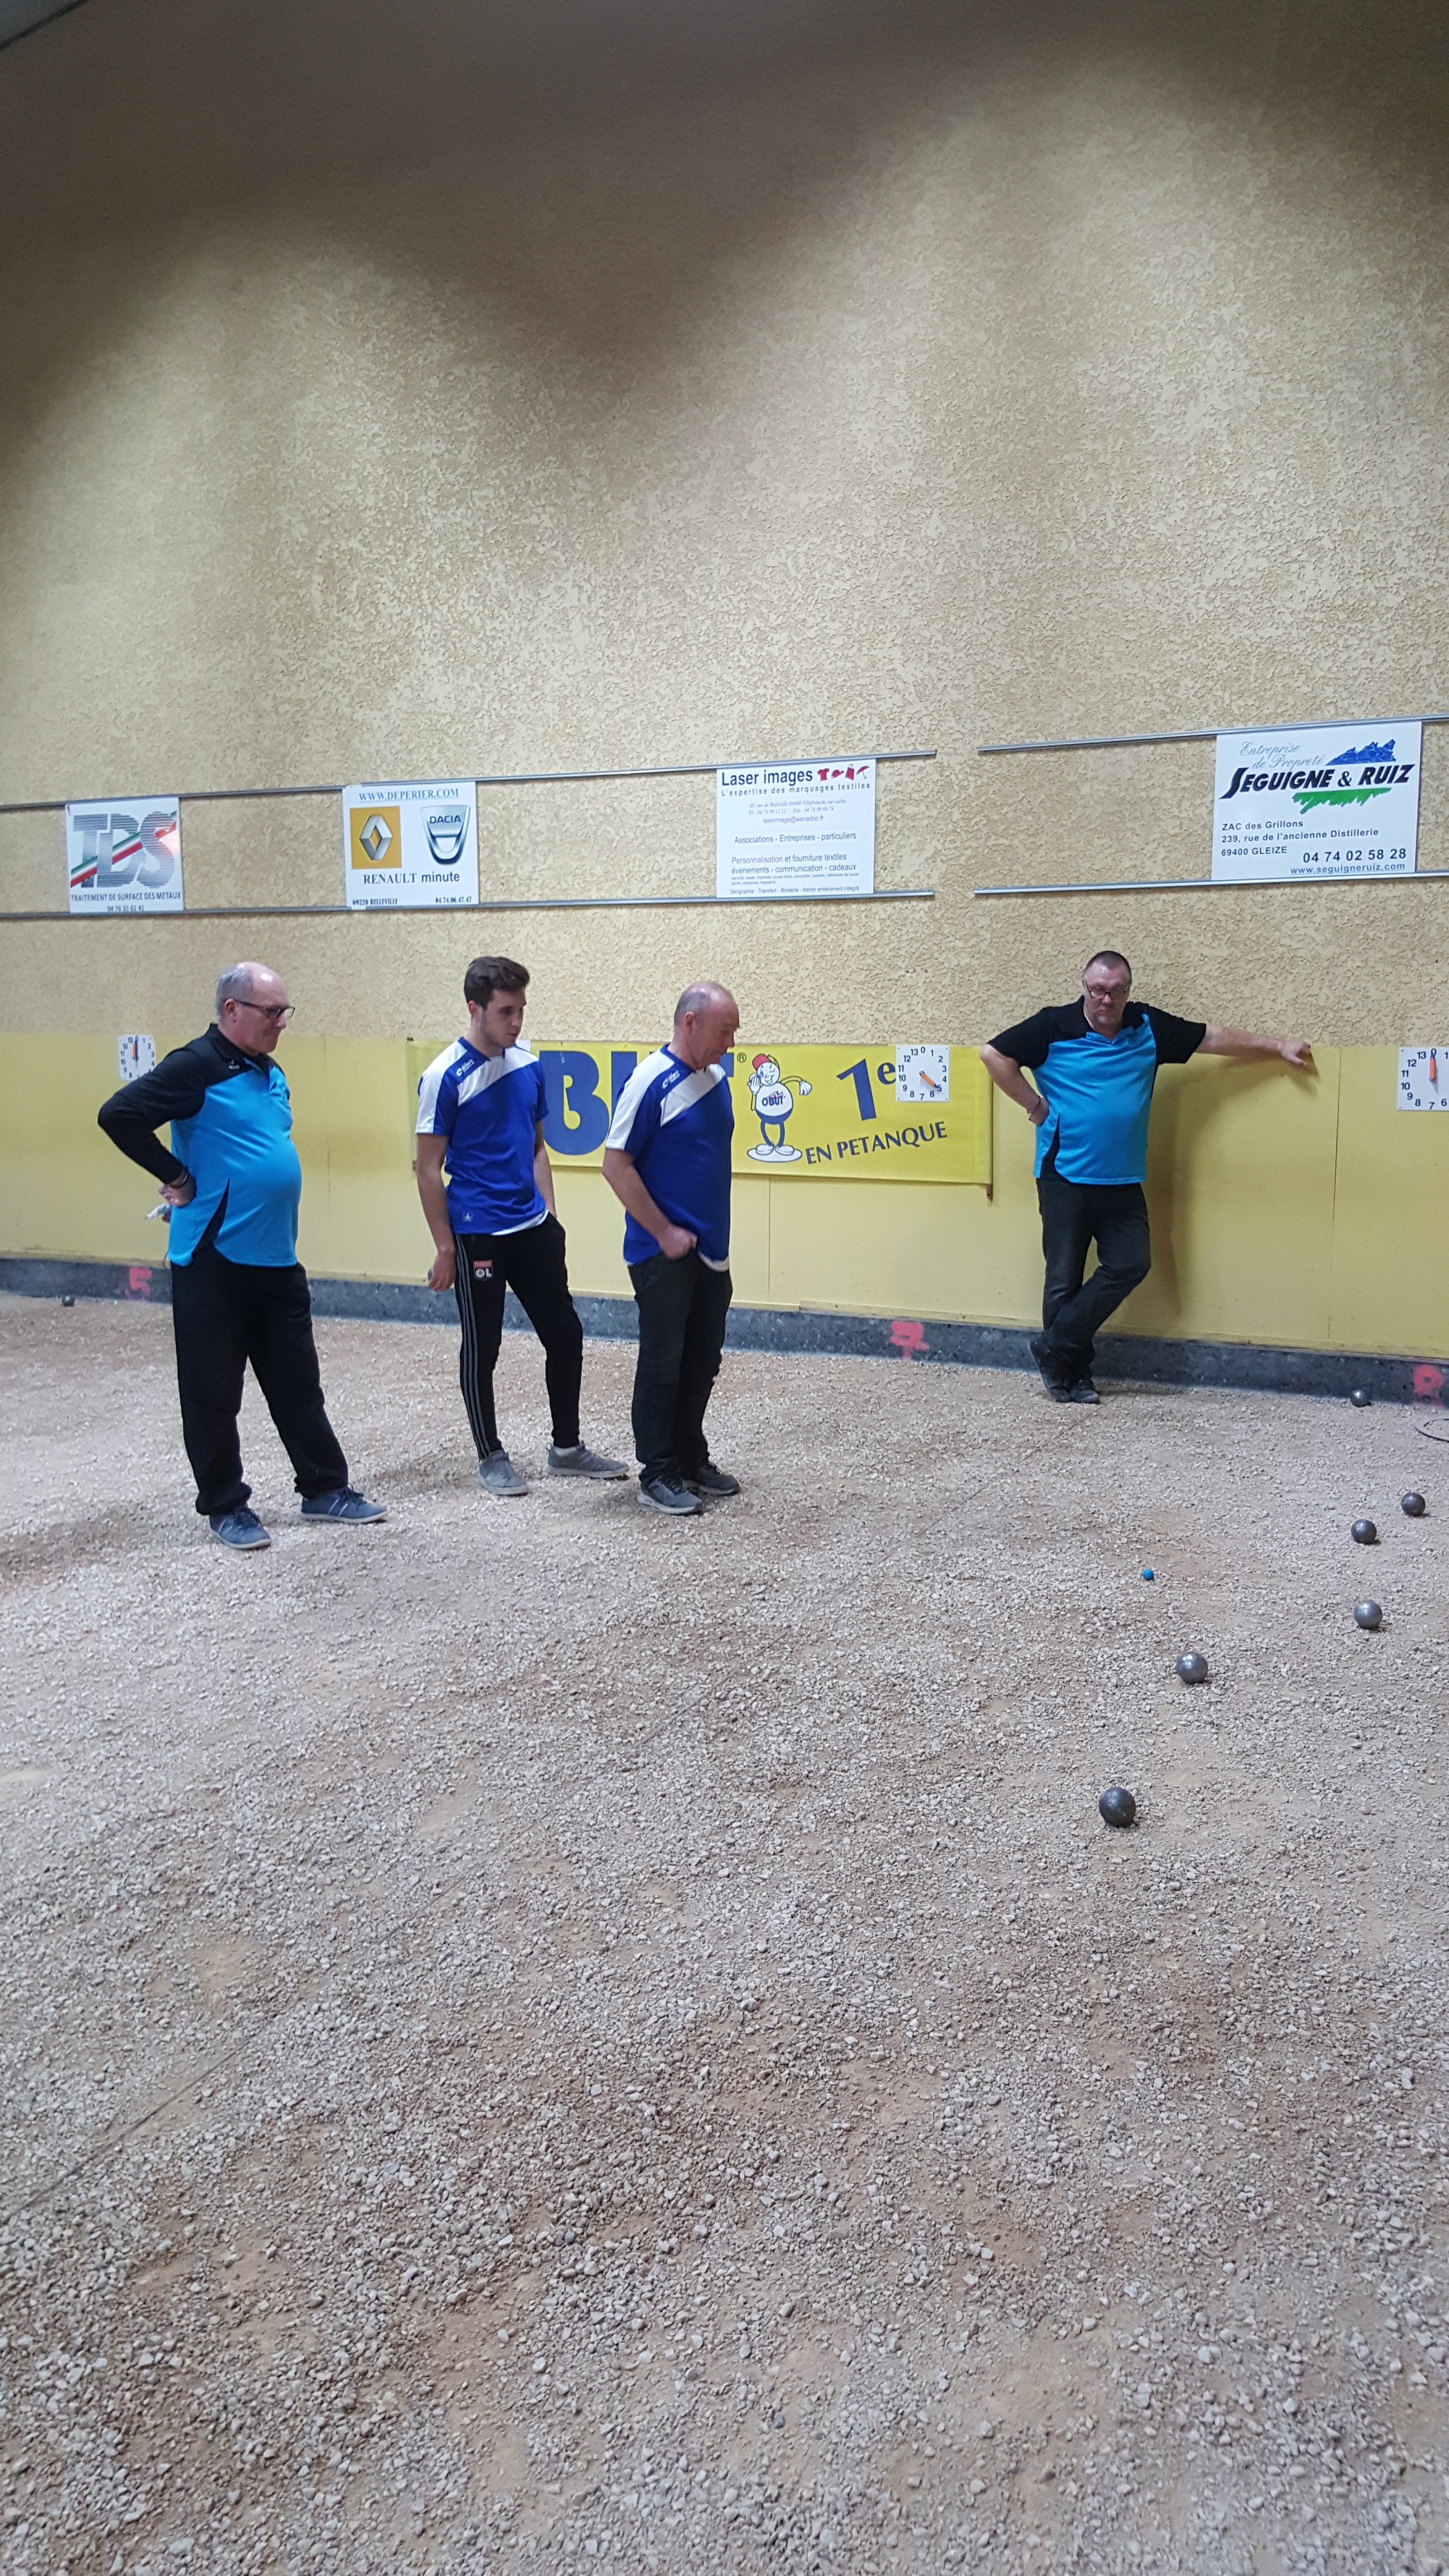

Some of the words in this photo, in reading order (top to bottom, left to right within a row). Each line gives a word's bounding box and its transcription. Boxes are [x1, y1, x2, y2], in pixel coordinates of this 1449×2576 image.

[1240, 741, 1300, 758] Entreprise
[1252, 757, 1266, 769] de
[1269, 754, 1326, 770] Propreté
[722, 772, 759, 786] Laser
[763, 770, 813, 787] images
[1219, 767, 1335, 799] SEGUIGNE
[1337, 771, 1352, 787] &
[1358, 764, 1416, 785] RUIZ
[359, 788, 459, 801] WWW.DEPERIER.COM
[722, 788, 767, 797] L'expertise
[789, 785, 834, 794] marquages
[838, 783, 870, 791] textiles
[429, 815, 461, 824] DACIA
[1265, 820, 1304, 829] Grillons
[780, 834, 815, 842] Entreprises
[821, 833, 856, 842] particuliers
[1222, 835, 1241, 844] 239,
[1277, 831, 1327, 841] l'ancienne
[1331, 828, 1378, 838] Distillerie
[73, 811, 175, 889] TDS
[1221, 848, 1248, 856] 69400
[1252, 846, 1287, 855] GLEIZE
[731, 856, 783, 864] Personnalisation
[1303, 853, 1319, 863] 04
[1324, 852, 1341, 862] 74
[1346, 851, 1362, 861] 02
[1368, 849, 1384, 860] 58
[1389, 849, 1406, 859] 28
[775, 864, 823, 873] communication
[1290, 862, 1405, 874] www.seguigneruiz.com
[364, 873, 417, 885] RENAULT
[421, 871, 460, 882] minute
[71, 894, 107, 902] TRAITEMENT
[1401, 1069, 1409, 1078] 11
[1401, 1082, 1410, 1090] 10
[762, 1096, 783, 1107] OBUT
[1415, 1099, 1421, 1107] 8
[1441, 1099, 1447, 1107] 6
[805, 1144, 832, 1164] EN
[837, 1121, 948, 1160] PETANQUE
[475, 1268, 492, 1278] OL
[125, 1267, 152, 1300] 5
